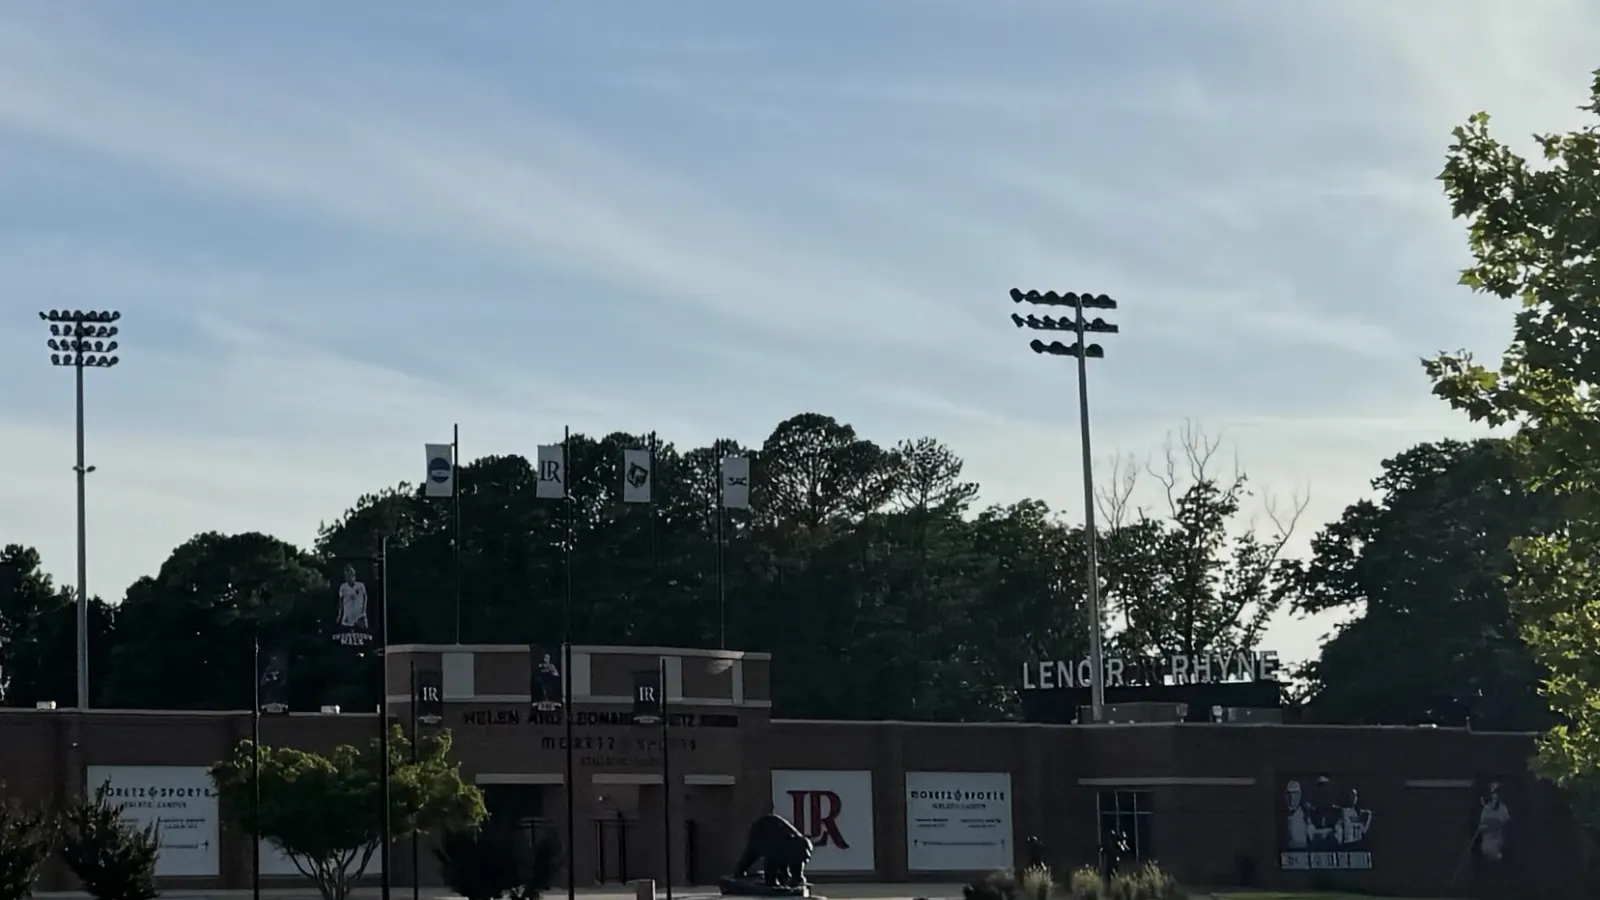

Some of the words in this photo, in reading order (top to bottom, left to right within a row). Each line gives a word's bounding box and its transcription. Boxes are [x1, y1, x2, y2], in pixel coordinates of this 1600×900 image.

[540, 460, 562, 484] LR
[1023, 658, 1125, 689] LENOR
[1171, 650, 1280, 684] RHYNE
